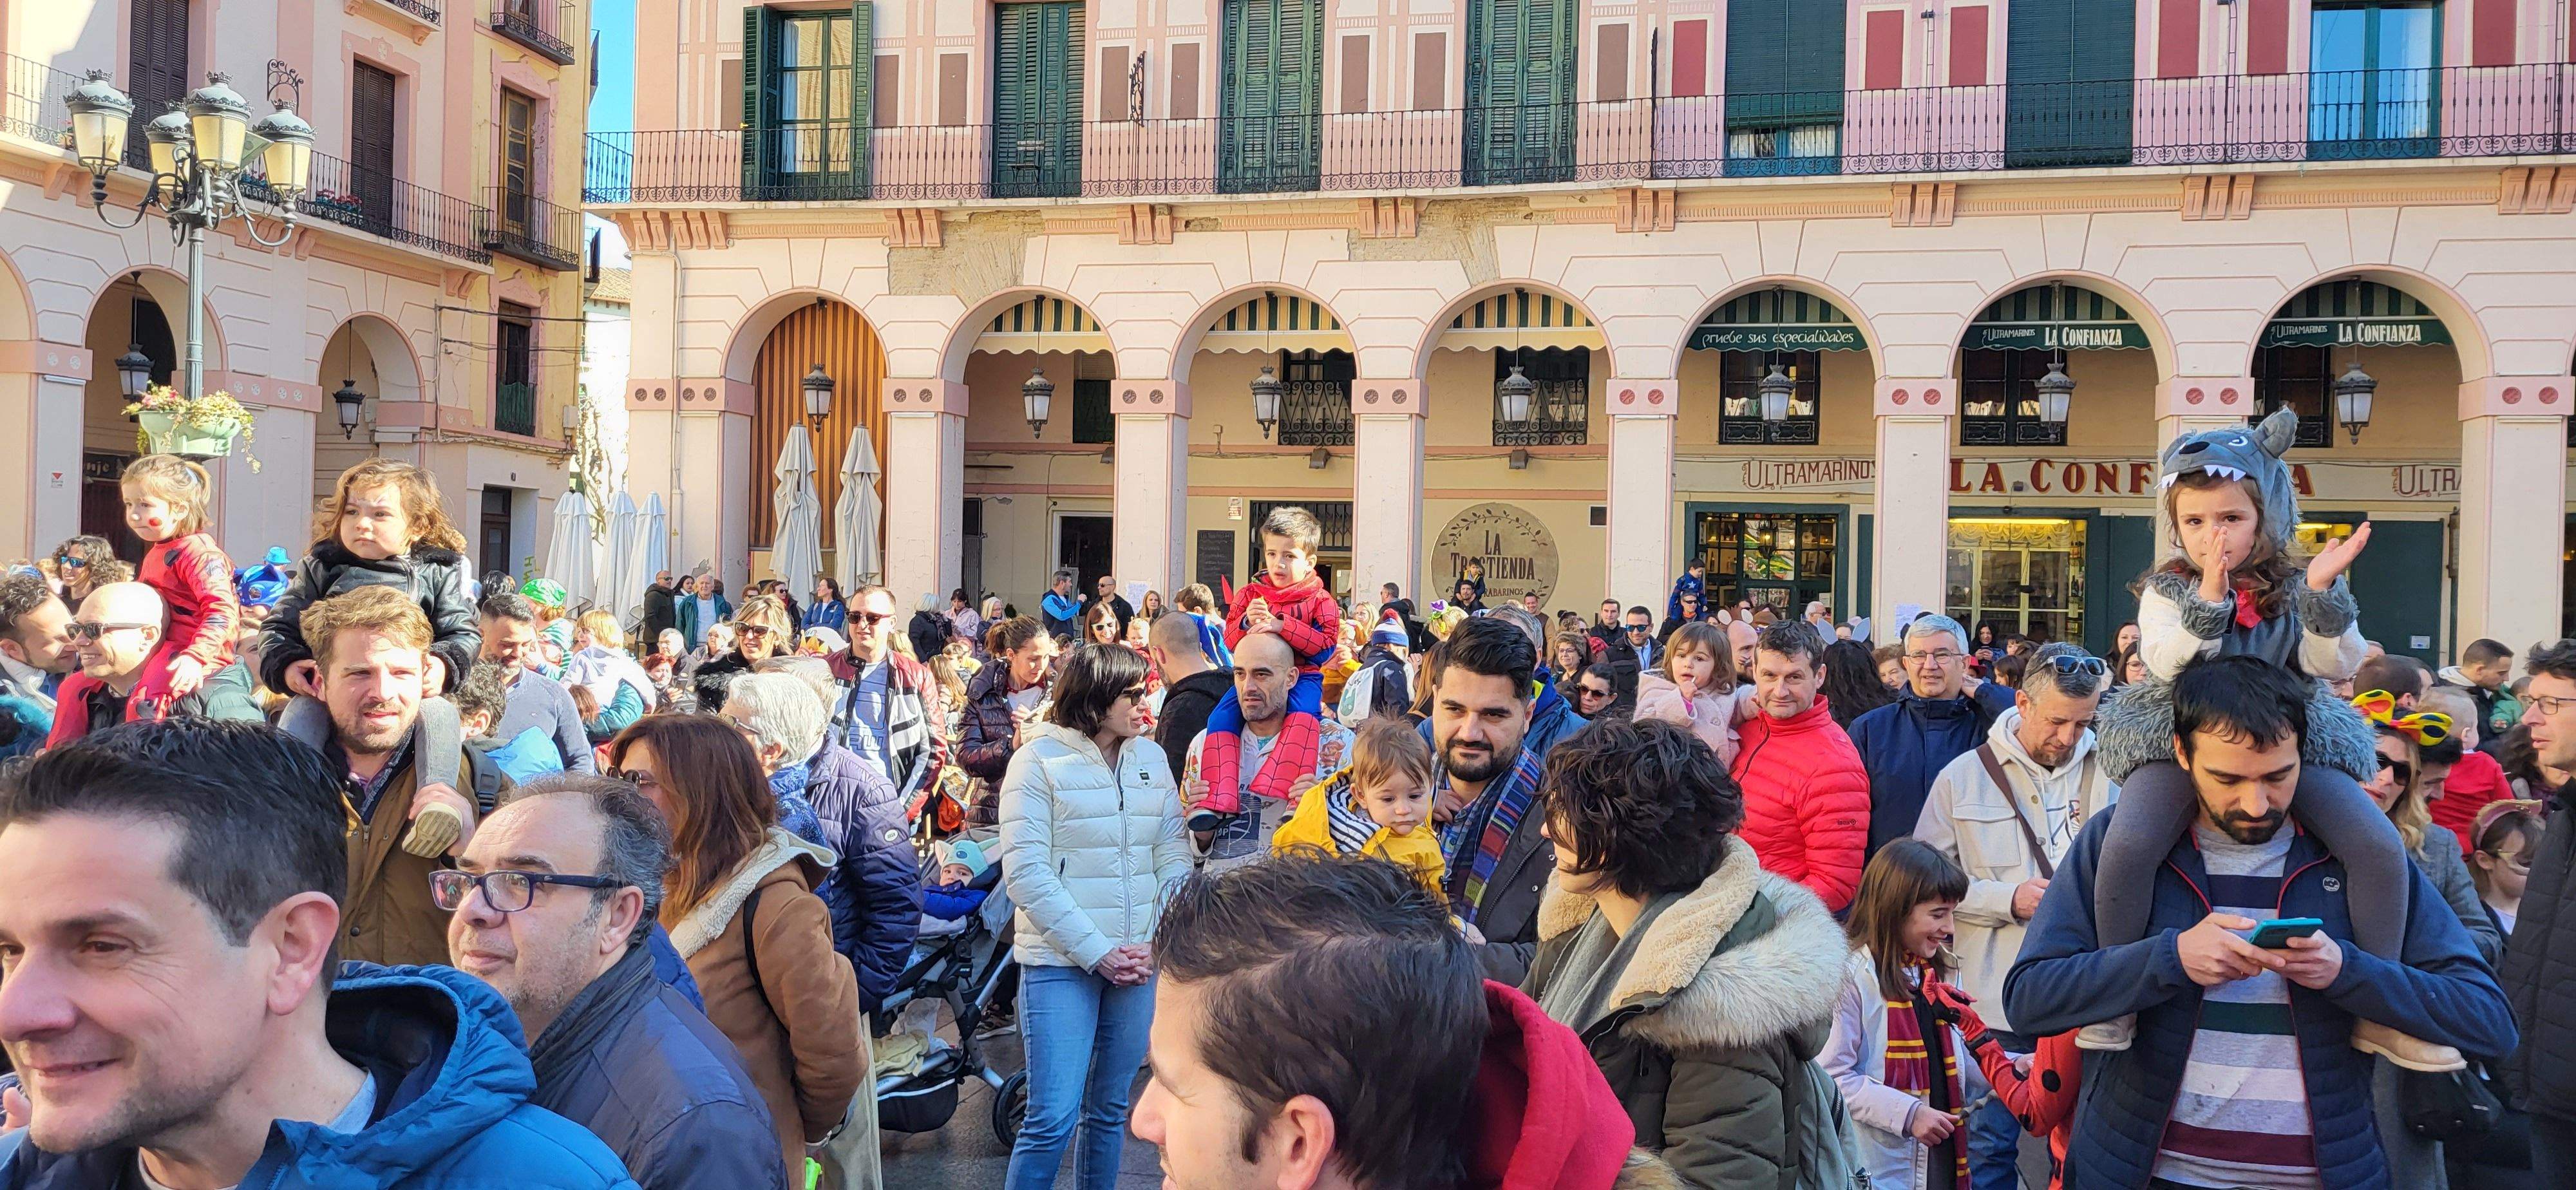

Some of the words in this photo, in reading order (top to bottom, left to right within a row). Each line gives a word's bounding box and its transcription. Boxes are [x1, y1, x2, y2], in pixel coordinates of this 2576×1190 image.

[1702, 330, 1743, 347] pruebe
[1748, 334, 1766, 343] sus
[1772, 330, 1854, 348] especialidades
[1988, 328, 2036, 341] ULTRAMARINOS
[2044, 327, 2058, 346] LA
[2062, 327, 2123, 346] CONFIANZA
[2277, 325, 2327, 338] ULTRAMARINOS
[2338, 323, 2353, 342] LA
[2357, 323, 2421, 342] CONFIANZA
[1949, 458, 2007, 493] LA
[1484, 530, 1501, 555] LA
[1450, 552, 1535, 580] TRSTIENDA
